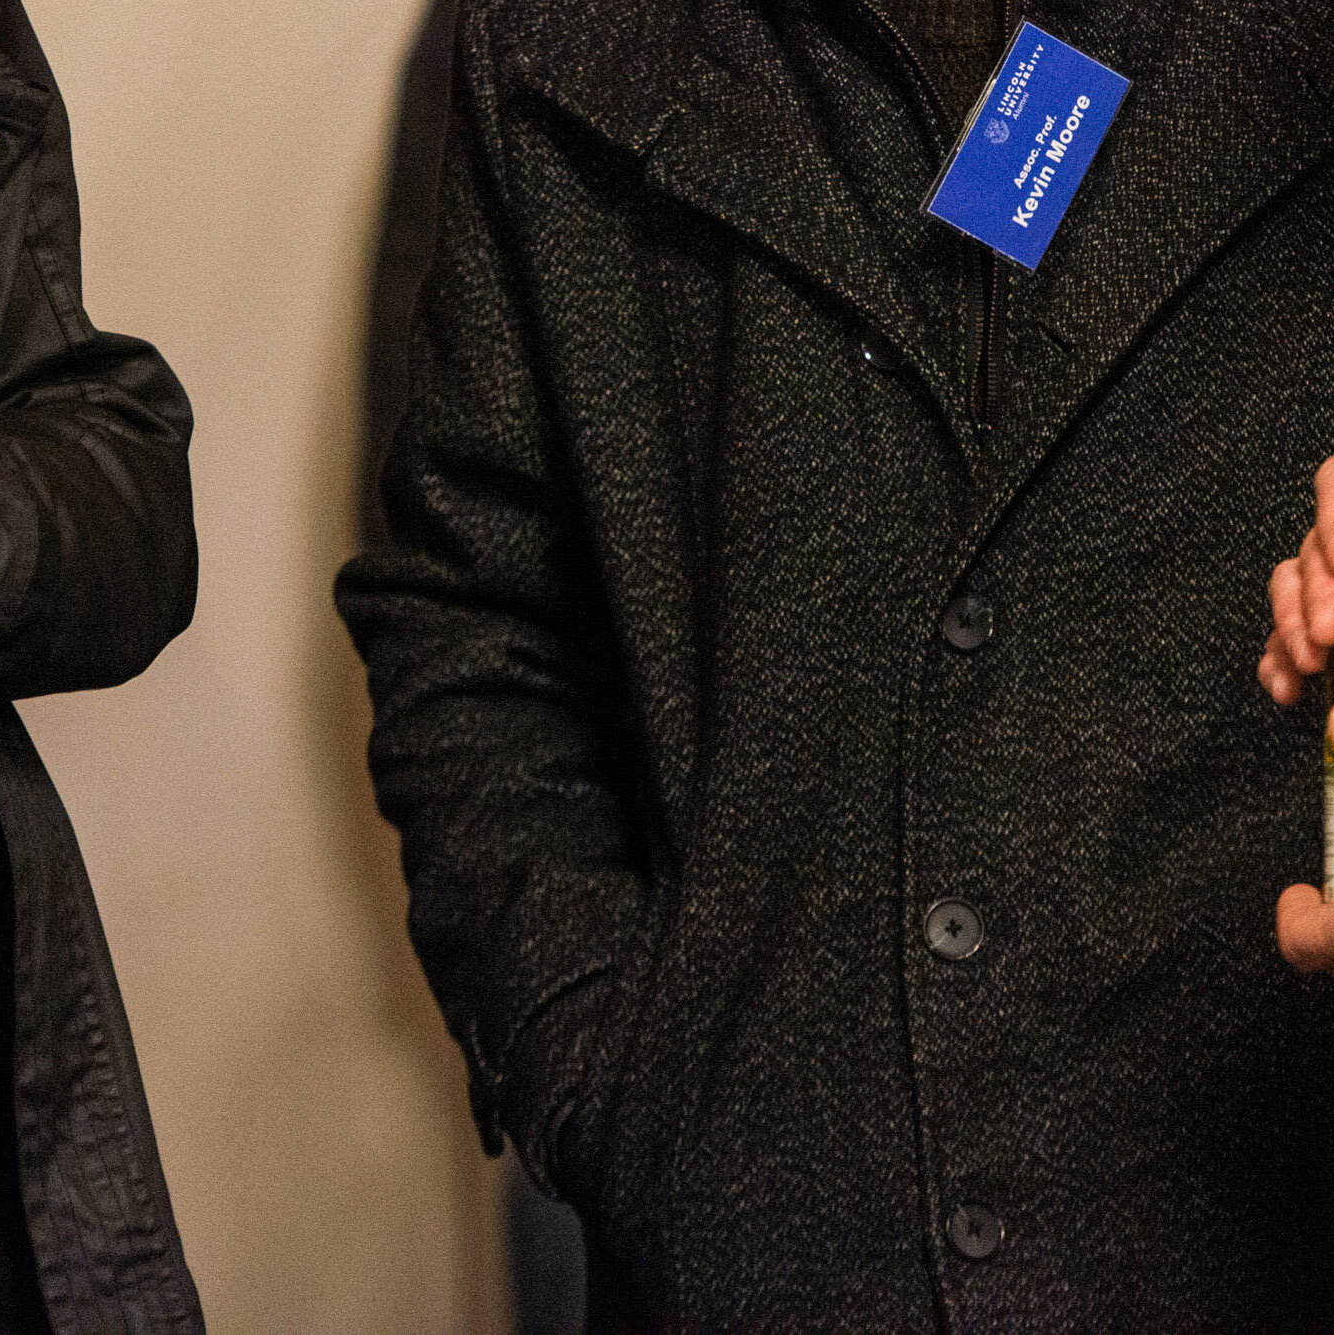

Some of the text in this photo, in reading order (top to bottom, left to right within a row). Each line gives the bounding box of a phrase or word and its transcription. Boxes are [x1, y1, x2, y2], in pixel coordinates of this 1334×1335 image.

[997, 61, 1026, 113] LINCOLN
[1004, 44, 1044, 116] UNIVERSITY
[1012, 91, 1029, 121] Alumni
[1012, 95, 1091, 228] Kevin Moore
[1013, 114, 1058, 189] Assoc. Prof.
